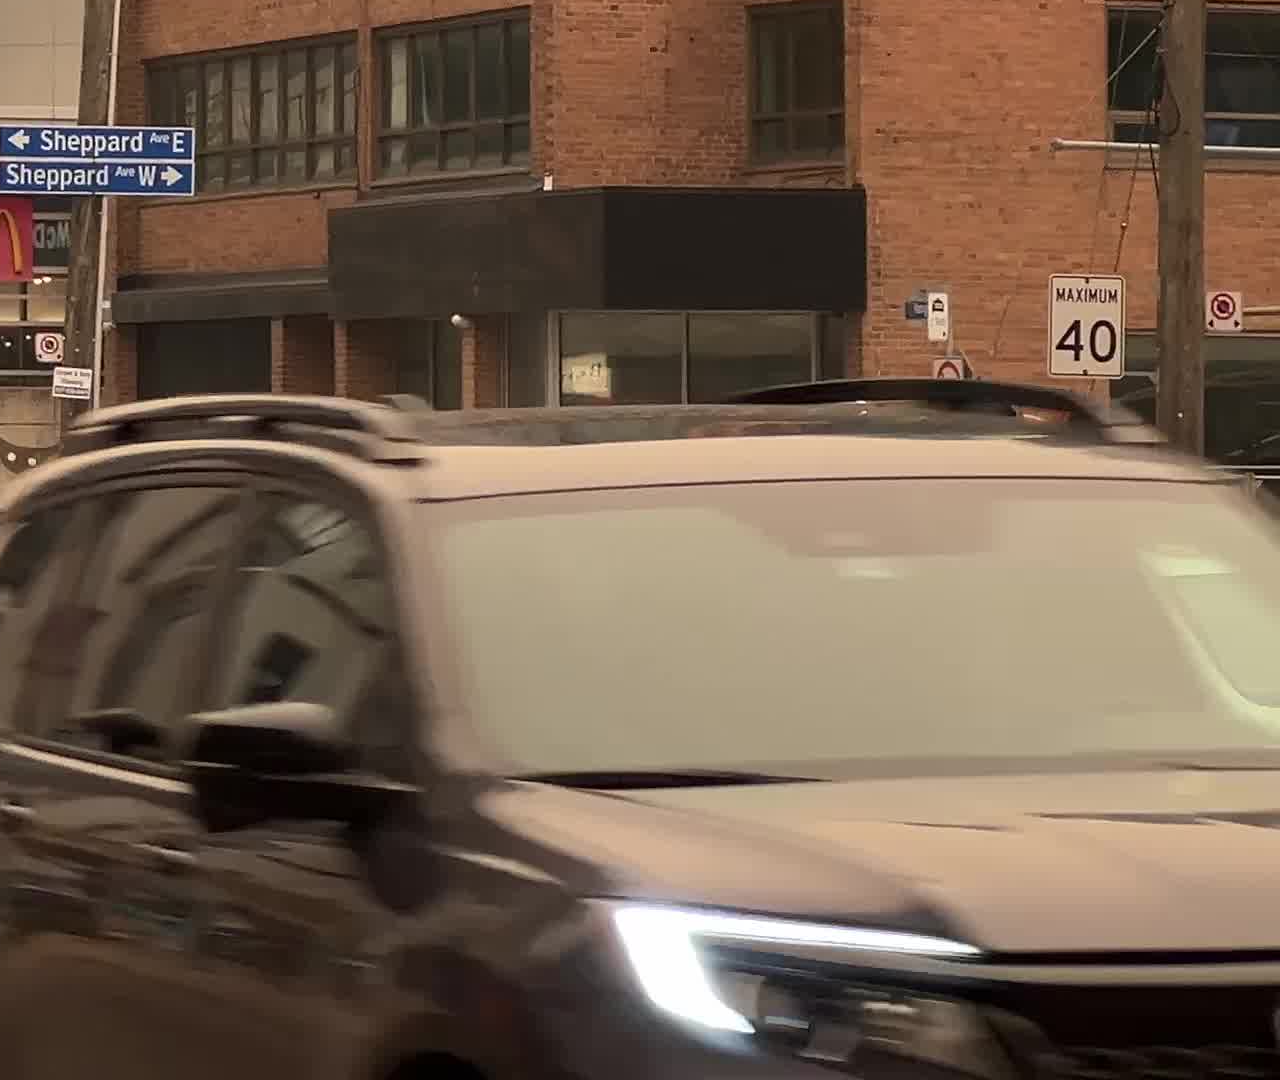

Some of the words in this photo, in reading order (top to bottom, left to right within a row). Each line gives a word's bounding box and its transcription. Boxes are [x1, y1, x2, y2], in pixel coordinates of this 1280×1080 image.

[41, 129, 143, 156] Sheppard
[150, 132, 169, 144] Ave
[172, 132, 185, 152] E
[6, 163, 109, 190] Sheppard
[115, 166, 135, 177] Ave
[138, 166, 156, 186] W
[1056, 288, 1118, 304] MAXIMUM
[1055, 320, 1117, 362] 40
